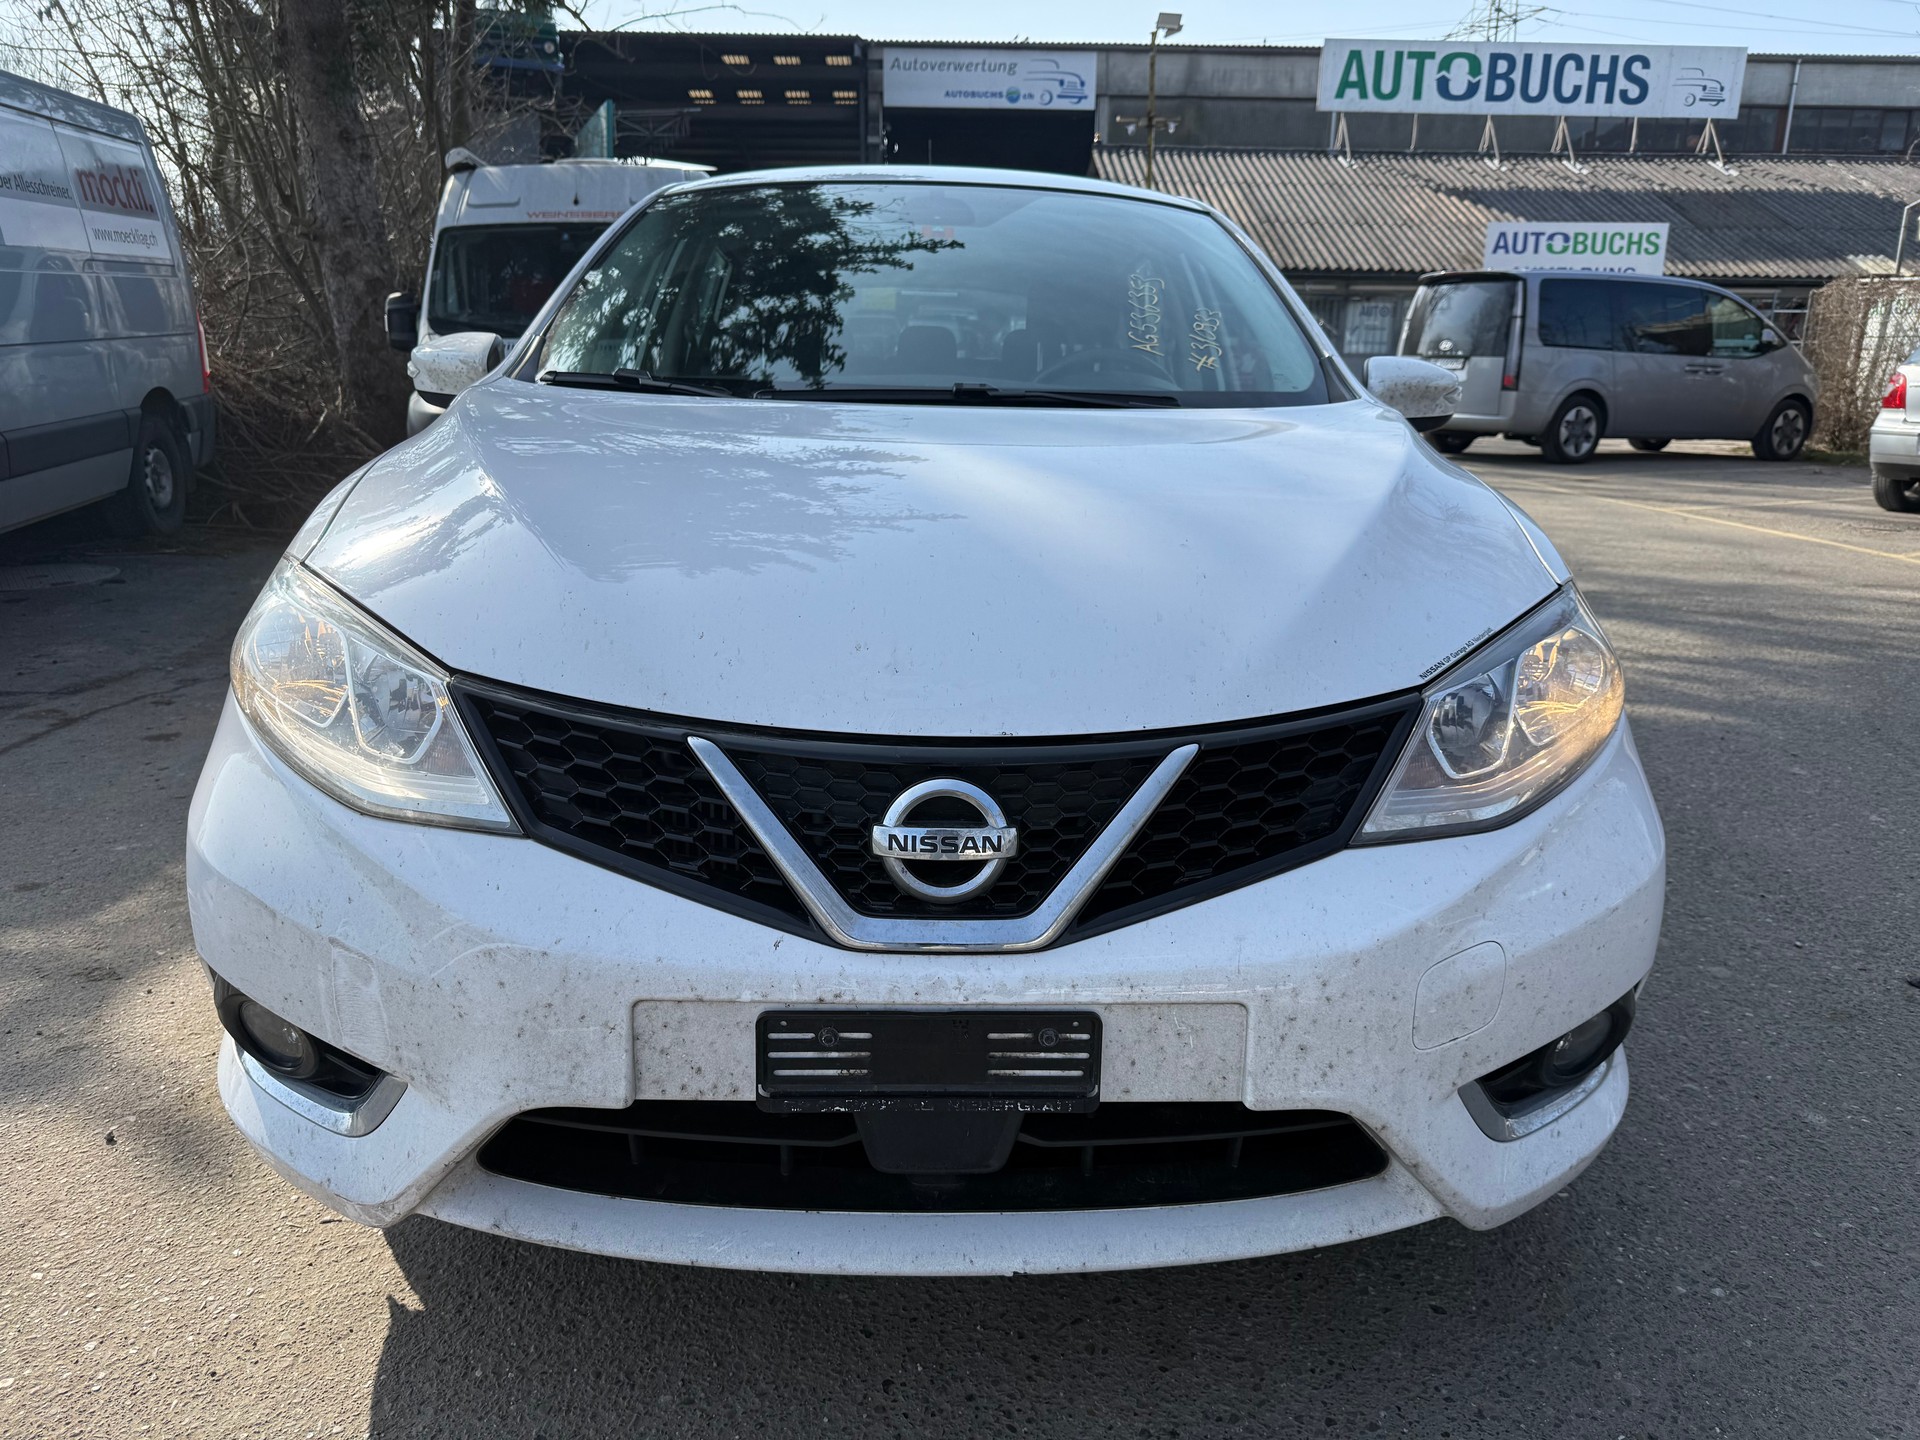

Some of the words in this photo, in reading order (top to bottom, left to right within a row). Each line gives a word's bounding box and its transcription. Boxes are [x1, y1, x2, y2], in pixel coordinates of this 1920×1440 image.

[889, 56, 1018, 76] Autoverwertung
[1334, 49, 1651, 105] AUTOBUCHS
[91, 227, 159, 249] www.moeckliag.ch
[1491, 231, 1661, 256] AUTOBUCHS
[1418, 660, 1446, 680] NISSAN
[888, 833, 1002, 853] NISSAN
